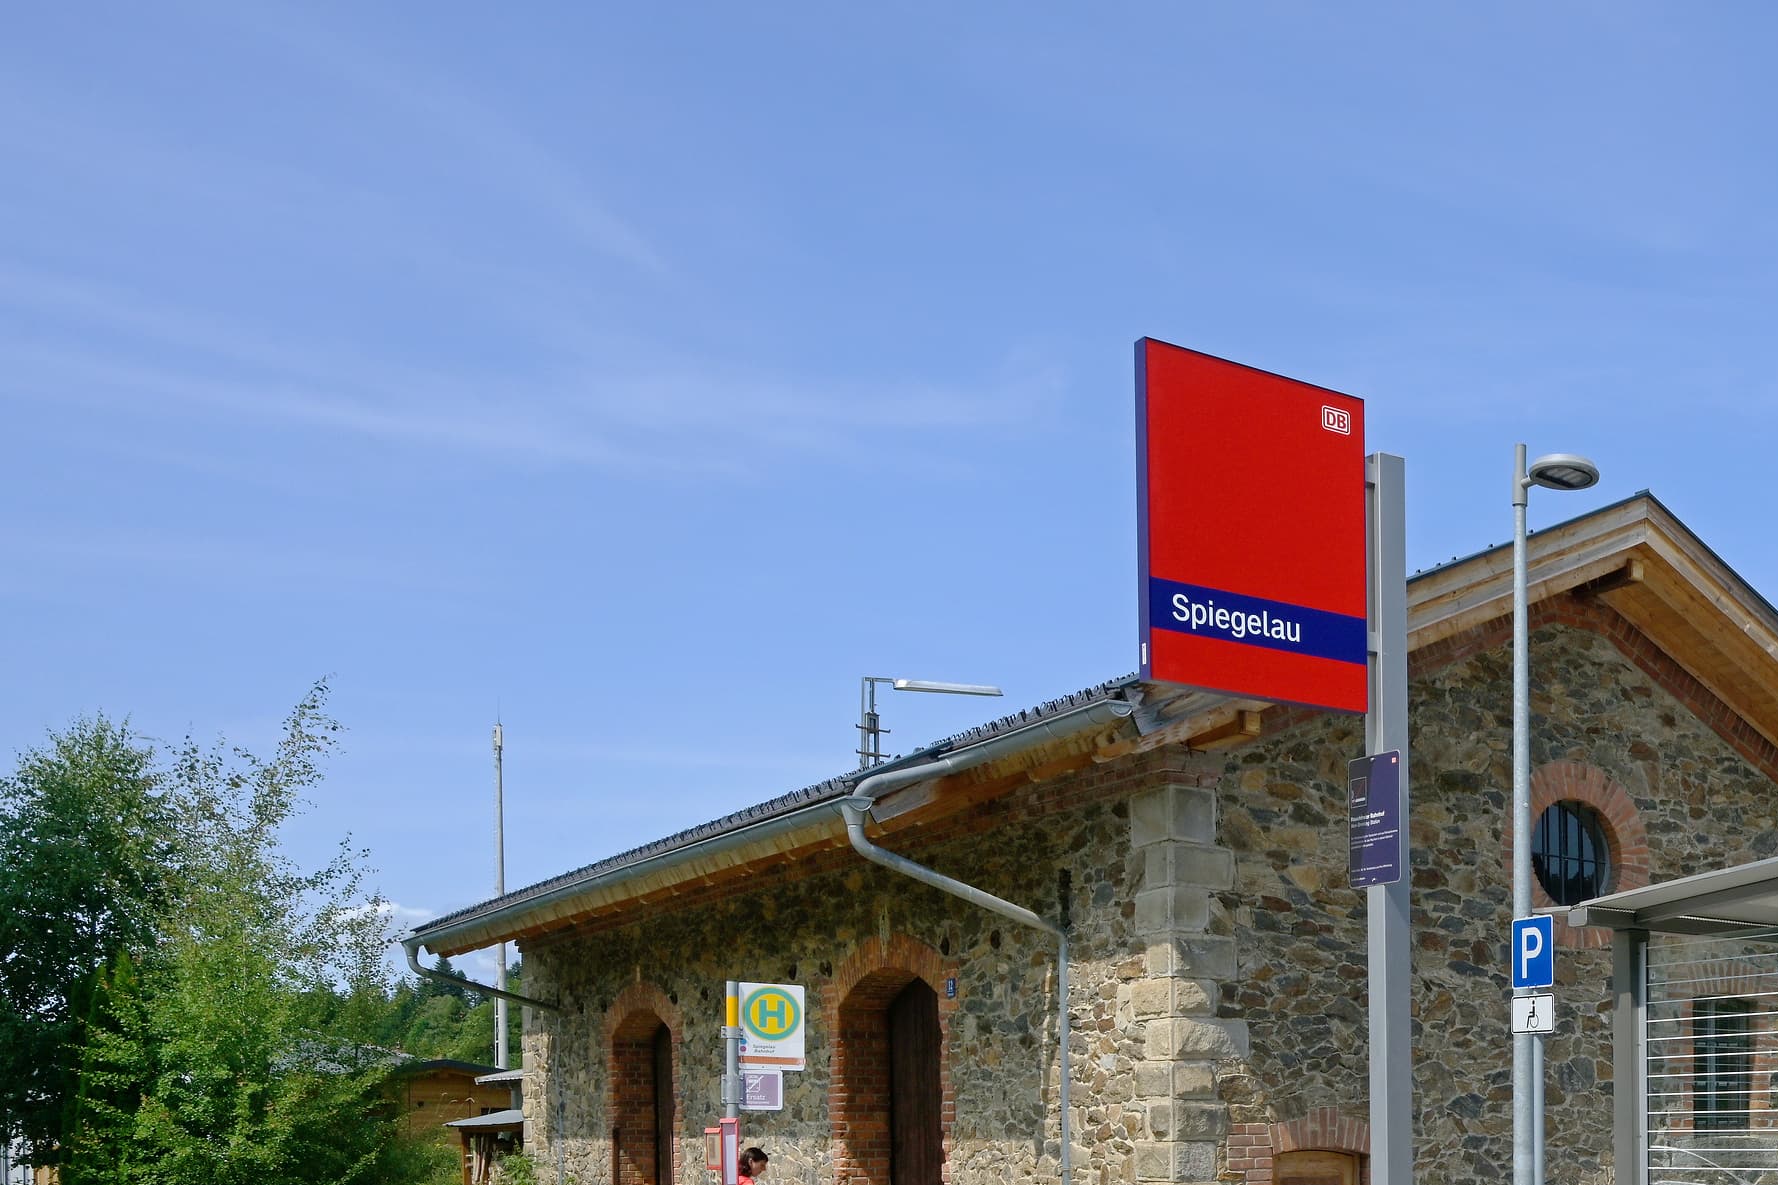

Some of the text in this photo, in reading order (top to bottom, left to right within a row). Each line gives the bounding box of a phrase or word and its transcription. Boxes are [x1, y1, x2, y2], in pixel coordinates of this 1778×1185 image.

[1325, 409, 1348, 431] DB
[1171, 593, 1301, 644] Spiegelau
[1521, 926, 1543, 979] P
[758, 999, 785, 1029] H
